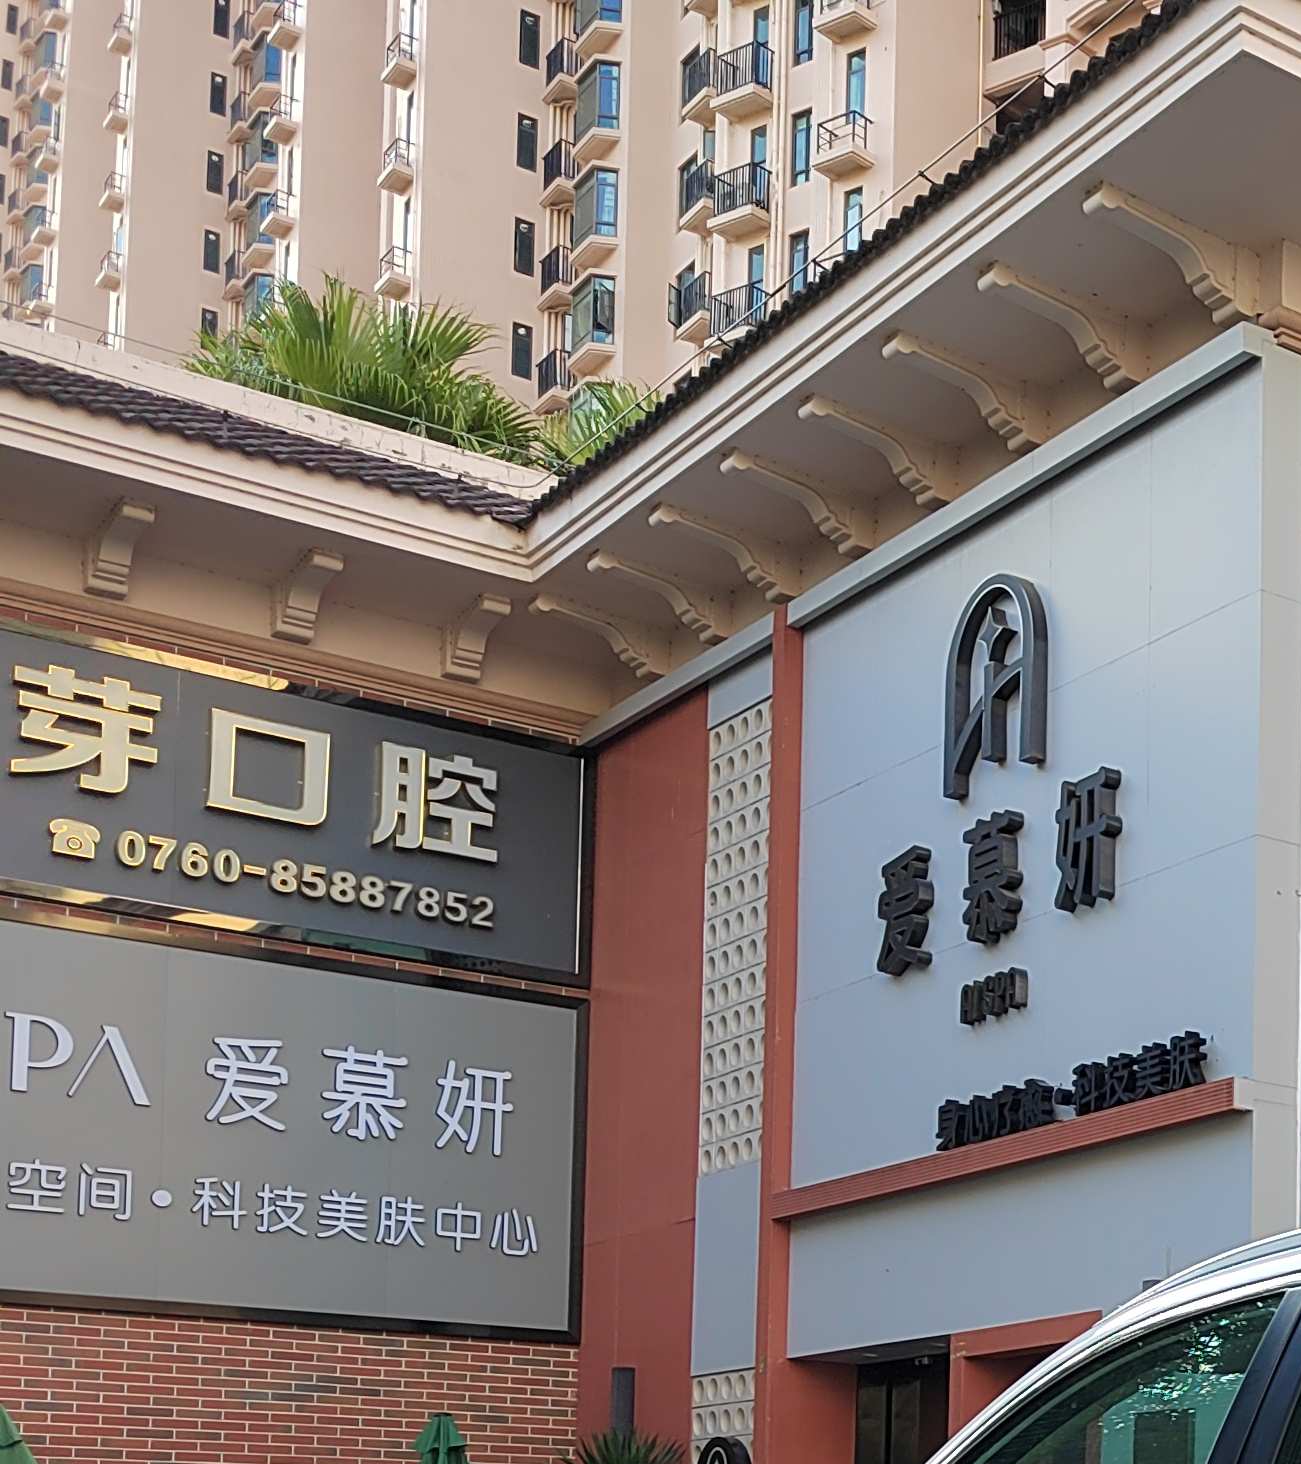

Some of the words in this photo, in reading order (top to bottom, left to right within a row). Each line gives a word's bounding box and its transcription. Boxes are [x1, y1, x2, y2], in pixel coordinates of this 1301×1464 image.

[10, 663, 498, 864] 芽口腔
[115, 829, 496, 929] 0760-85887852
[876, 766, 1123, 977] 爱慕妍
[205, 1036, 514, 1157] 爱慕妍
